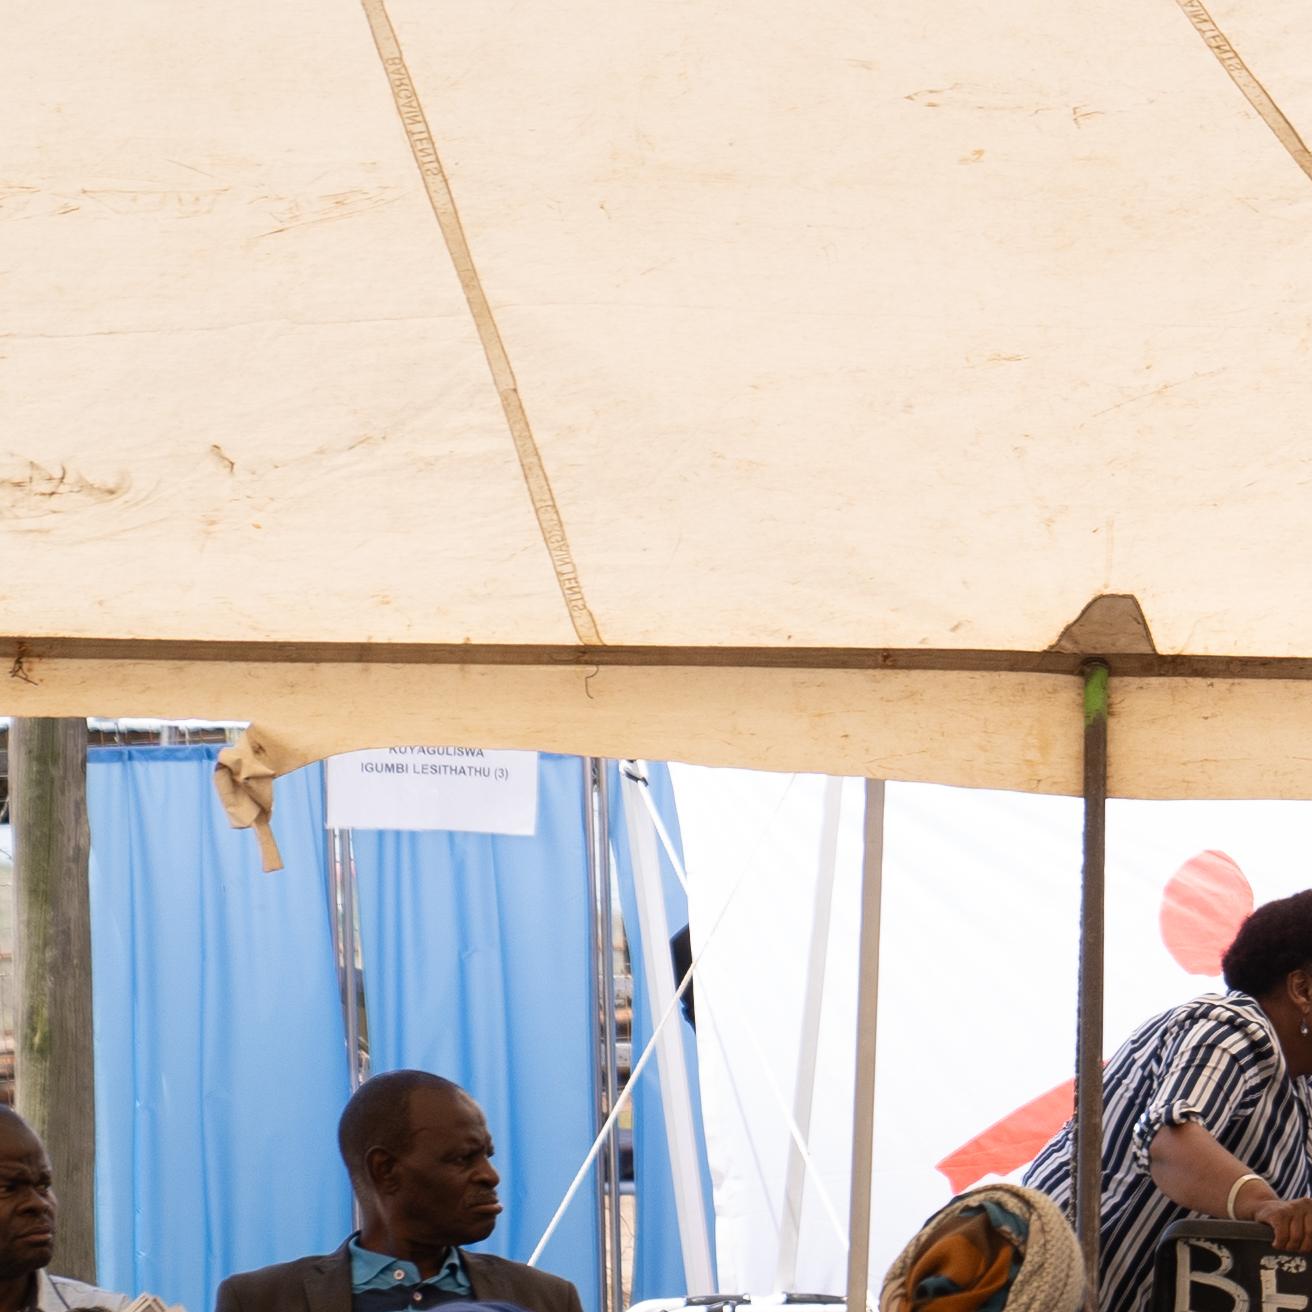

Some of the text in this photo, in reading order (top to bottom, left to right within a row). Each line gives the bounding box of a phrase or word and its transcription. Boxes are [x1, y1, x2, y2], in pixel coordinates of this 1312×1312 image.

[360, 762, 509, 781] IGUMBI LESITHATHU (3)
